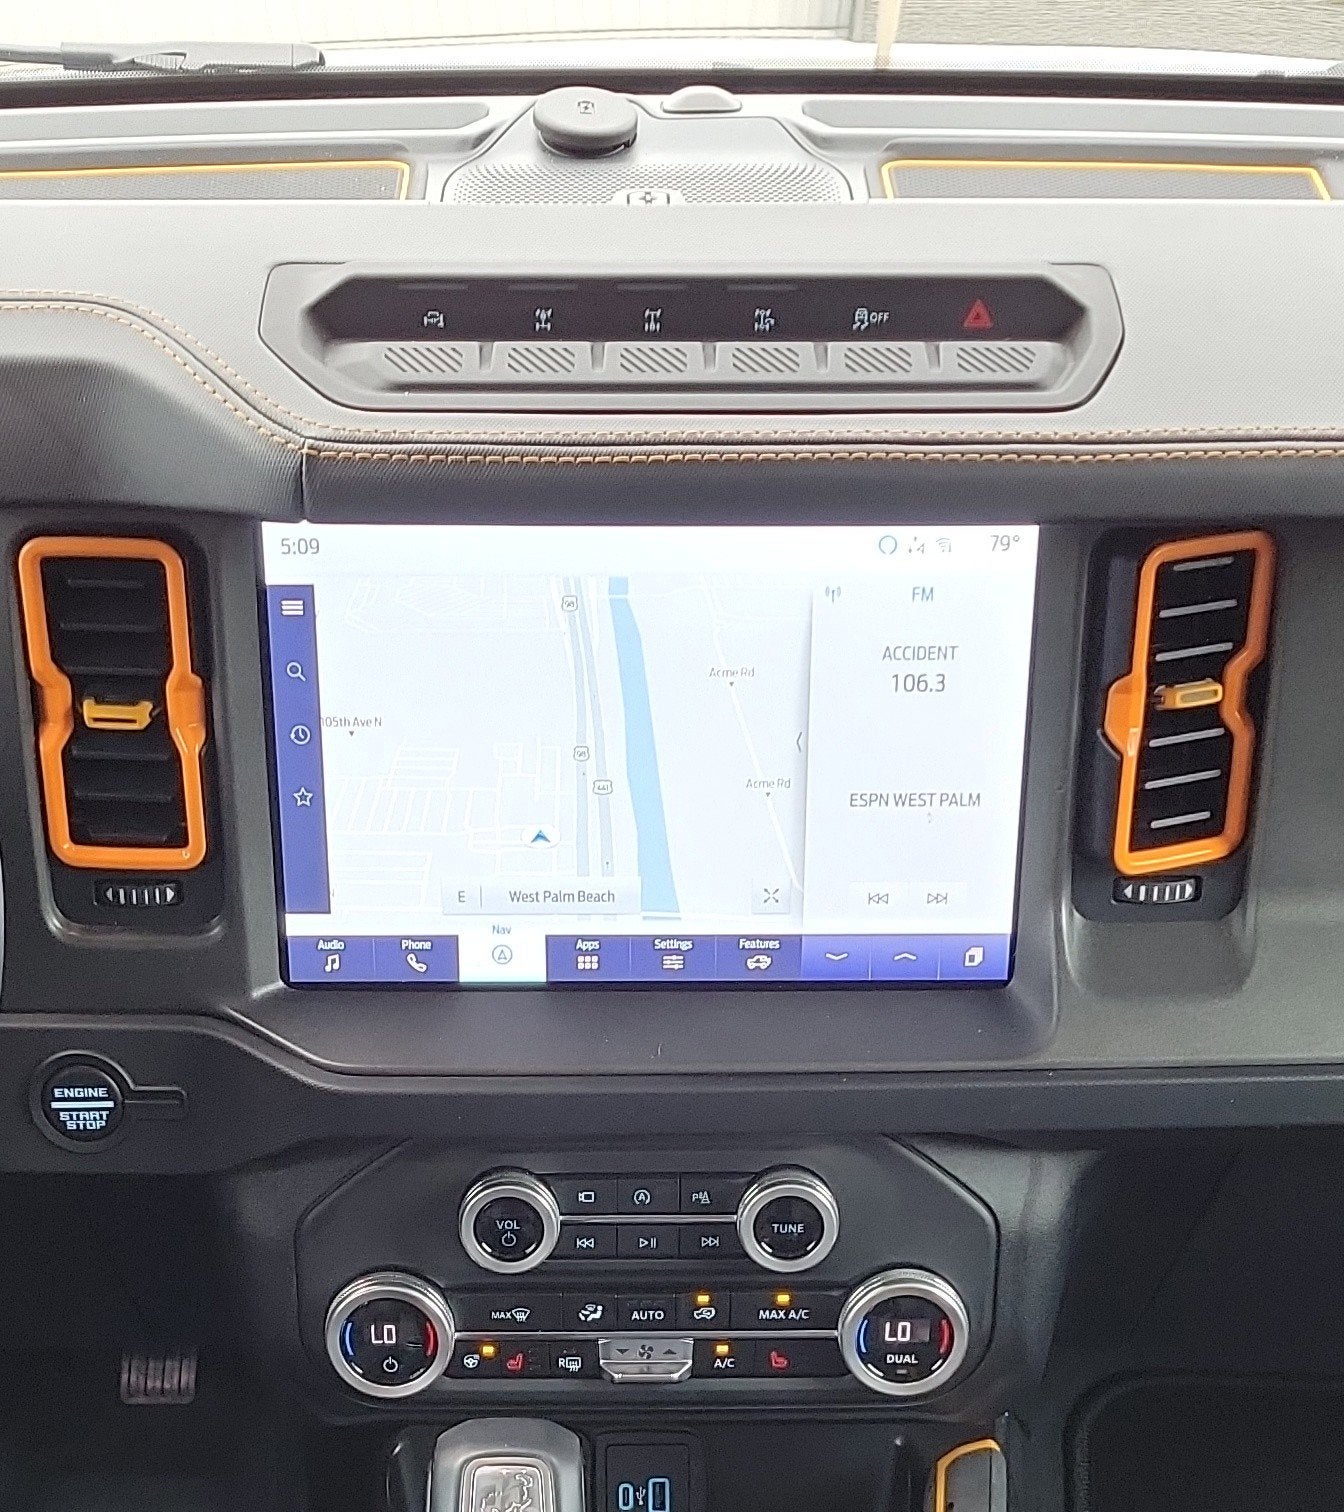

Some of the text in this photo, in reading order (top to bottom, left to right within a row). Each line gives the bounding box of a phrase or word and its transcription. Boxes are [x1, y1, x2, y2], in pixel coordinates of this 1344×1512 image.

[869, 312, 890, 324] OFF
[280, 537, 320, 555] 5:09
[990, 534, 1020, 552] 79°
[912, 586, 934, 602] FM
[882, 645, 959, 661] ACCIDENT
[891, 673, 946, 693] 106.3
[352, 717, 372, 728] Ave
[374, 717, 382, 728] N
[849, 792, 982, 808] ESPN WEST PALM
[458, 890, 466, 903] E
[508, 889, 615, 904] West Palm Beach
[492, 924, 512, 935] Nav
[317, 939, 345, 951] Audio
[401, 939, 432, 950] Phone
[575, 939, 600, 952] Apps
[654, 938, 693, 951] Settings
[739, 938, 780, 950] Features
[53, 1087, 109, 1098] ENGINE
[59, 1110, 110, 1121] START
[66, 1120, 106, 1130] STOP
[496, 1219, 521, 1230] VOL
[772, 1222, 804, 1234] TUNE
[490, 1310, 512, 1320] MAX
[631, 1309, 665, 1321] AUTO
[759, 1308, 810, 1320] MAX A/C
[714, 1358, 736, 1369] A/C
[886, 1353, 918, 1365] DUAL
